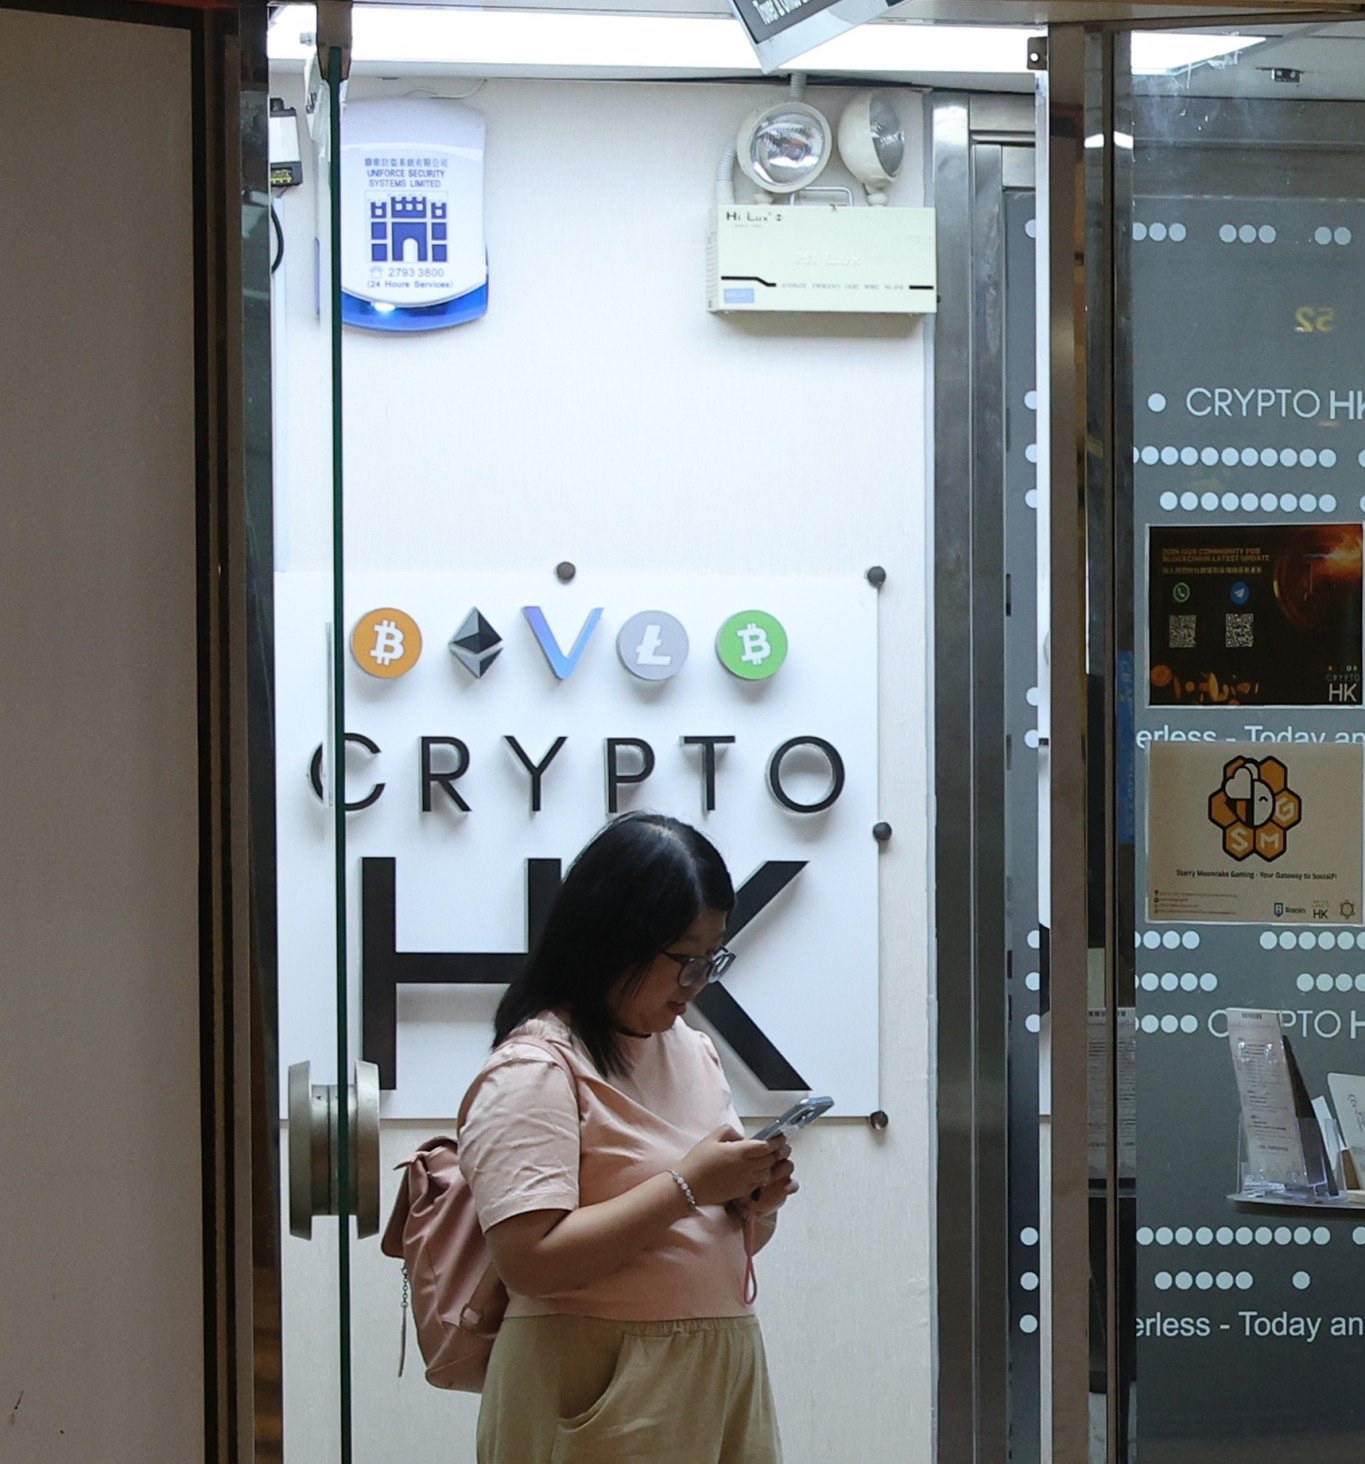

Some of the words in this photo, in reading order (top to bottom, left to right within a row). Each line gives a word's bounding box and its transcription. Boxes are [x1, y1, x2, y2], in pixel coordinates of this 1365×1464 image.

[366, 169, 405, 178] UNIFORCE
[408, 169, 445, 178] SECURITY
[368, 179, 407, 188] SYSTEMS
[409, 179, 441, 188] LIMITED
[388, 267, 416, 278] 2793
[417, 267, 445, 278] 3800
[384, 280, 410, 289] Hours
[1186, 386, 1320, 421] CRYPTO
[1328, 683, 1358, 702] HK
[306, 732, 847, 815] CRYPTO
[1312, 908, 1329, 919] HK
[1238, 1311, 1322, 1343] Today
